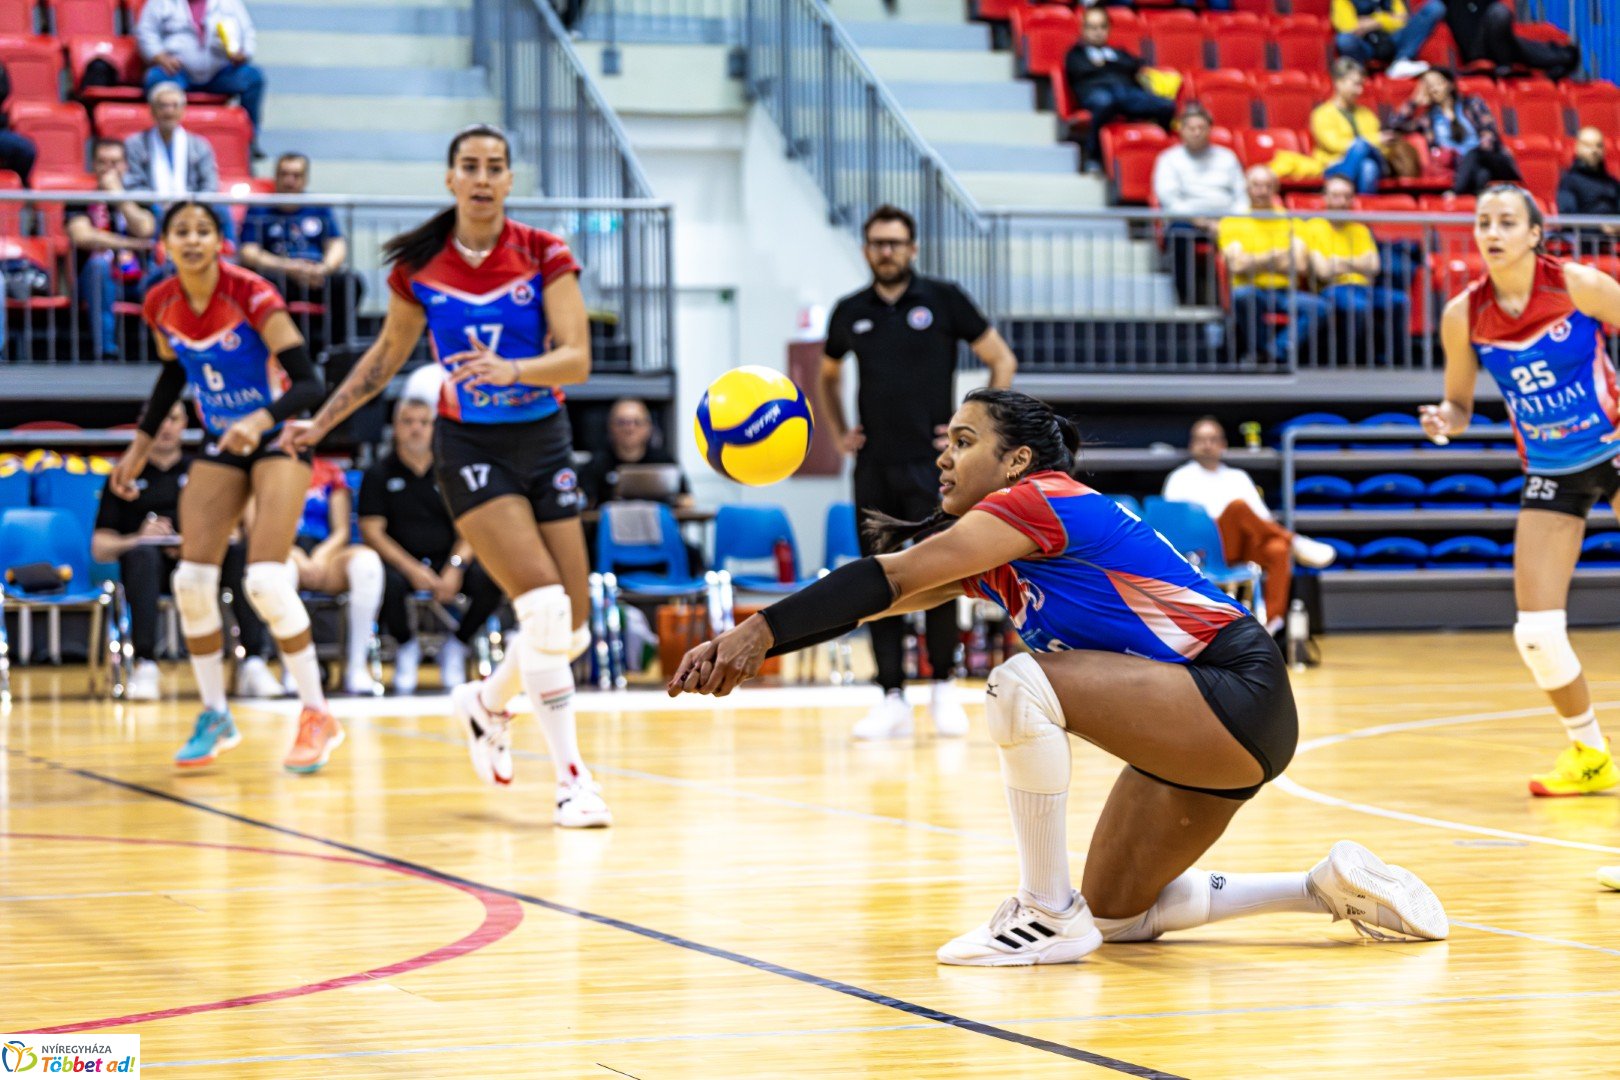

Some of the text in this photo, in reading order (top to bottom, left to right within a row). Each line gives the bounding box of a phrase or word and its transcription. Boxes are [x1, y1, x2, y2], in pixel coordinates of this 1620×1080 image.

[463, 323, 504, 354] 17
[202, 362, 226, 392] 6
[1510, 359, 1557, 395] 25
[460, 463, 491, 492] 17
[1525, 475, 1558, 500] 25
